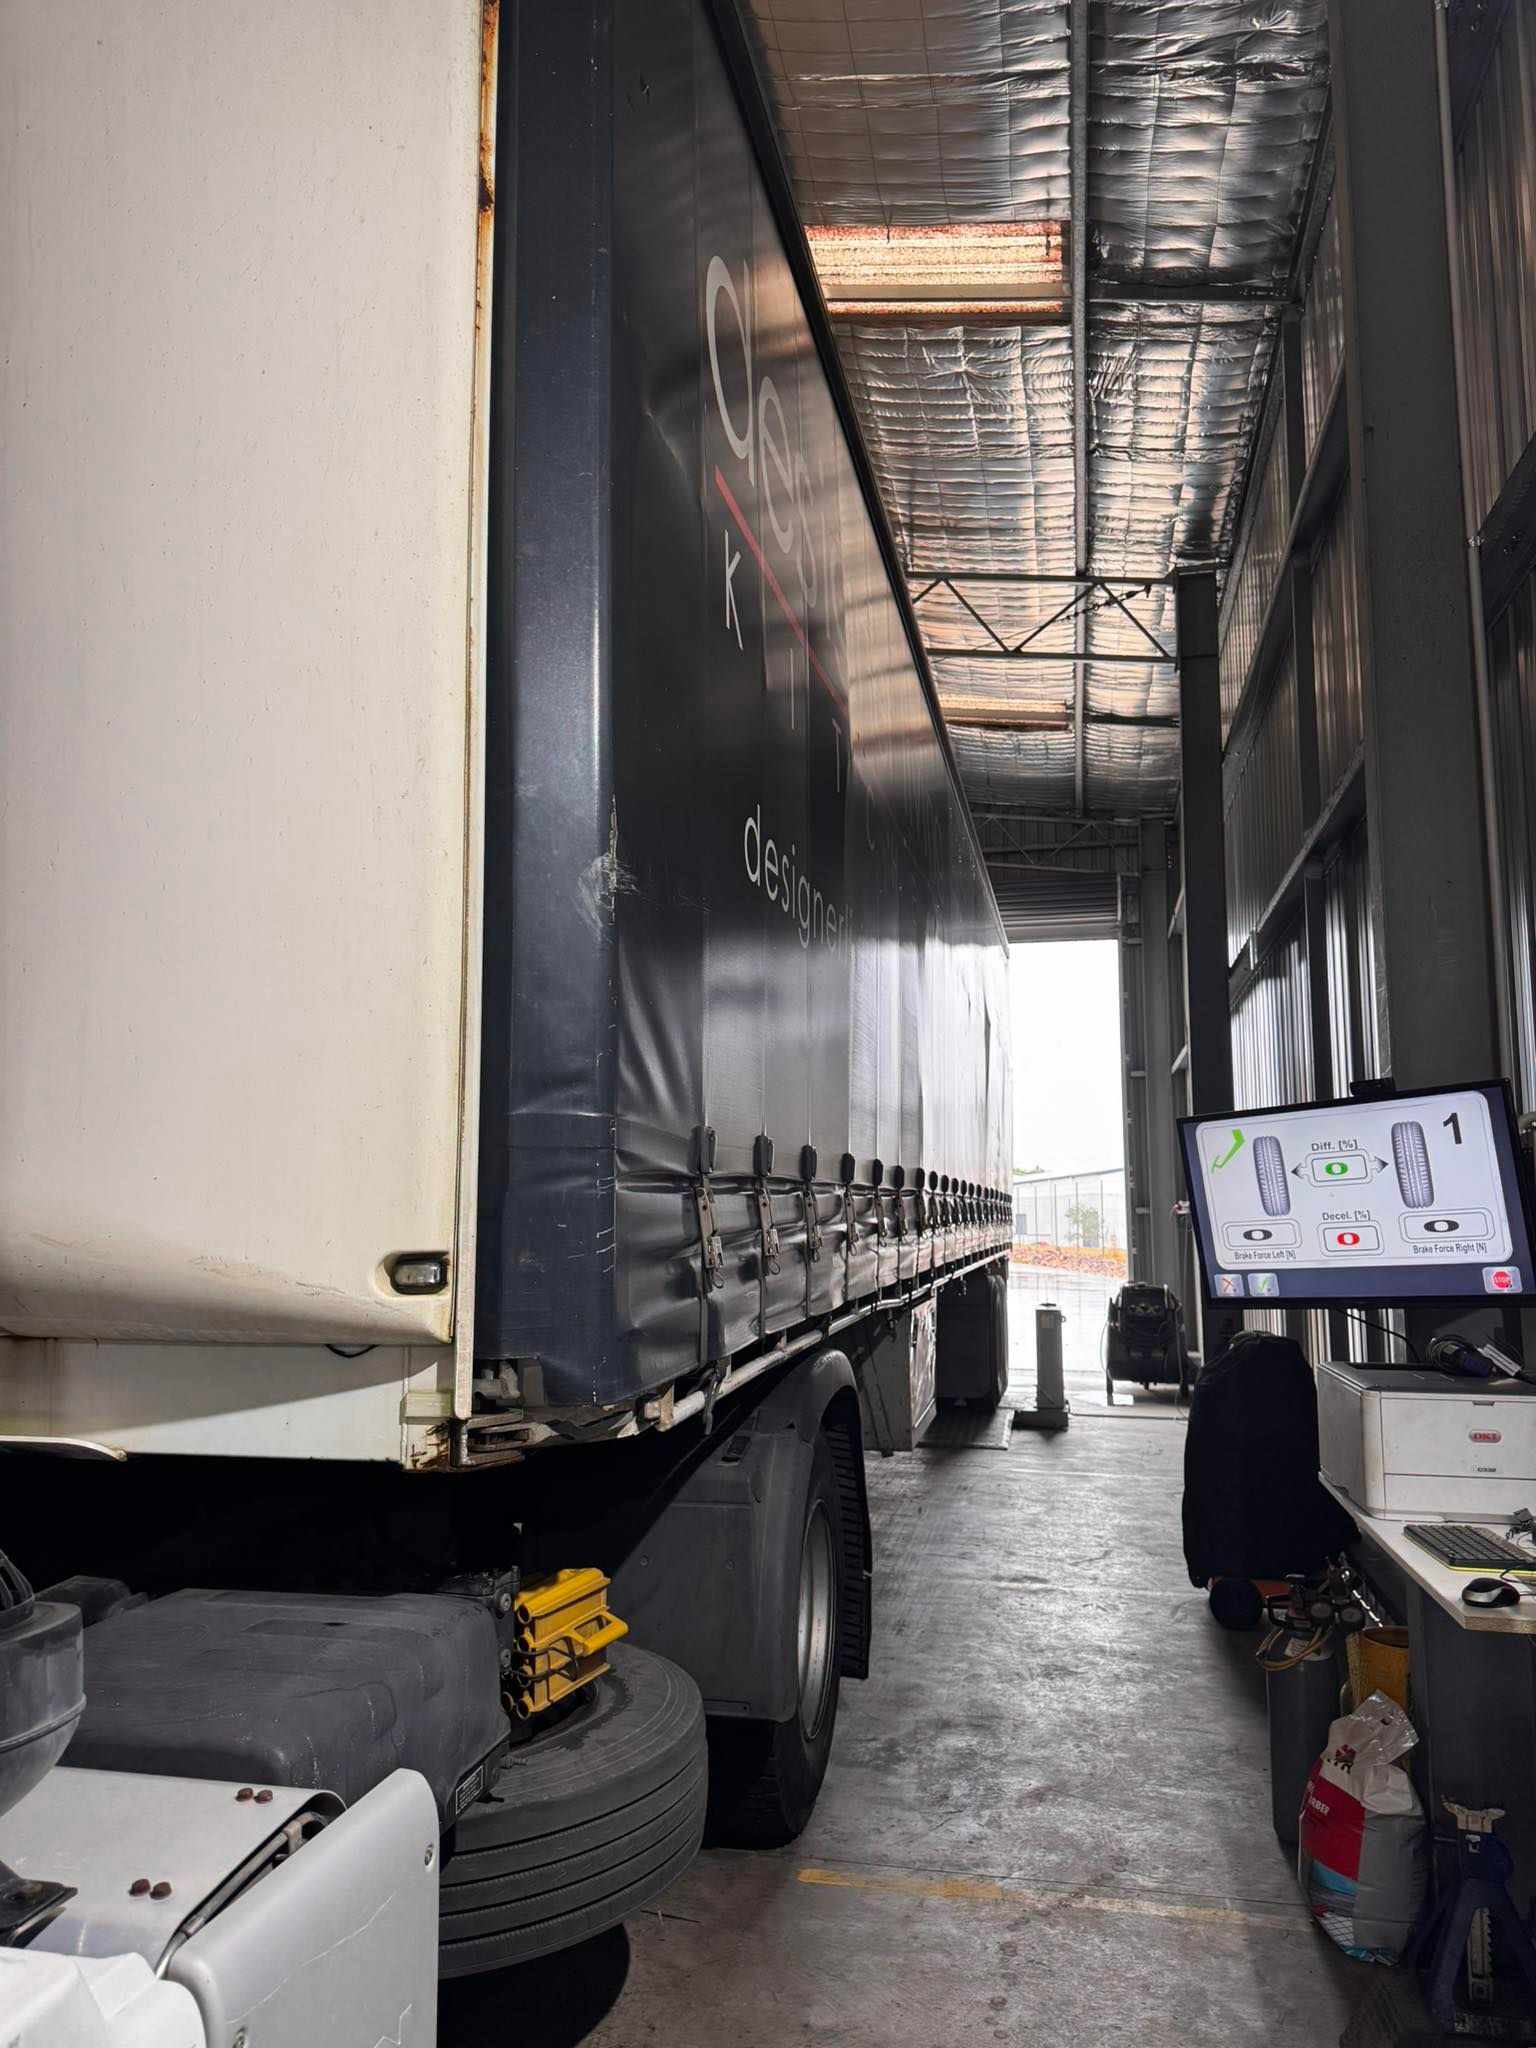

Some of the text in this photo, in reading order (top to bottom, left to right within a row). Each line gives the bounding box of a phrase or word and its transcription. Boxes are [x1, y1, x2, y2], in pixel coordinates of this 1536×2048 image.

[1443, 1112, 1463, 1145] 1
[1311, 1139, 1358, 1152] Diff. [%]
[1325, 1162, 1349, 1176] 0
[1322, 1212, 1352, 1221] Decel.
[1424, 1220, 1460, 1233] 0
[1243, 1229, 1273, 1241] 0
[1336, 1232, 1360, 1246] 0
[1413, 1242, 1487, 1254] Brake Force Right [N]
[1234, 1250, 1296, 1260] Brake Force Left [N]
[1471, 1432, 1498, 1441] OKI
